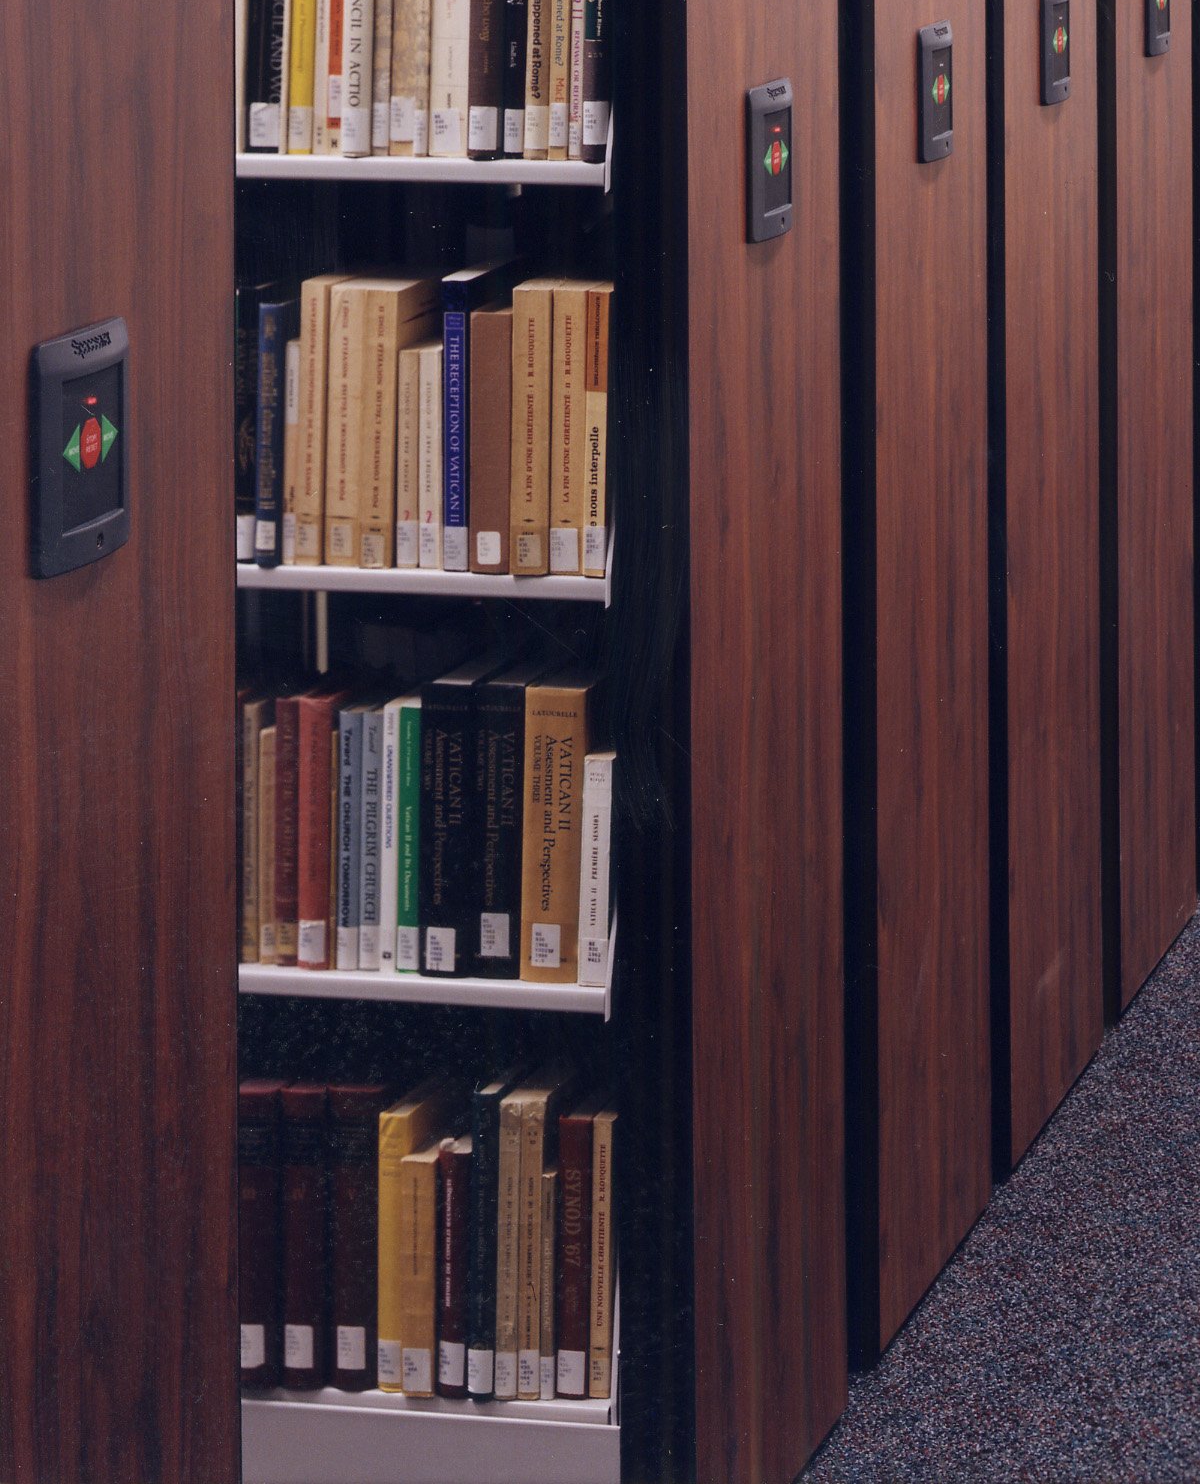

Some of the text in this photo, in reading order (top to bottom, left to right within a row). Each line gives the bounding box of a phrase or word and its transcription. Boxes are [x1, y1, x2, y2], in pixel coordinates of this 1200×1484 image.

[556, 23, 565, 33] at
[571, 9, 583, 20] II
[350, 38, 362, 53] IN
[532, 47, 541, 60] at
[554, 35, 565, 67] Rome?
[349, 60, 361, 107] ACTIO
[531, 60, 541, 100] Rome?
[450, 335, 459, 361] THE
[527, 317, 535, 368] ROUQUETTE
[564, 315, 572, 366] ROUQUETTE
[450, 363, 459, 433] RECEPTION
[526, 394, 534, 445] CHRÉTIENTÉ
[563, 395, 571, 446] CHRÉTIENTÉ
[373, 429, 381, 481] CONSTRUIRE
[450, 435, 459, 451] OF
[371, 485, 379, 508] POUR
[450, 455, 459, 504] VATICAN
[526, 490, 533, 503] LA
[563, 491, 570, 504] LA
[589, 426, 600, 518] nous interpelle
[450, 512, 459, 522] II
[343, 774, 351, 797] THE
[366, 768, 377, 797] THE
[449, 732, 462, 826] VATICAN II
[501, 732, 515, 827] VATICAN II
[532, 734, 541, 803] VOLUME THREE
[558, 736, 573, 831] VATICAN II
[342, 801, 351, 852] CHURCH
[365, 801, 377, 857] PILGRIM
[432, 729, 448, 905] Assessment and Perspectives
[485, 729, 499, 906] Assessment and Perspectives
[540, 735, 557, 912] Assessment and Perspectives
[340, 855, 350, 927] TOMORROW
[364, 862, 376, 921] CHURCH
[564, 1168, 581, 1267] SYNOD '67
